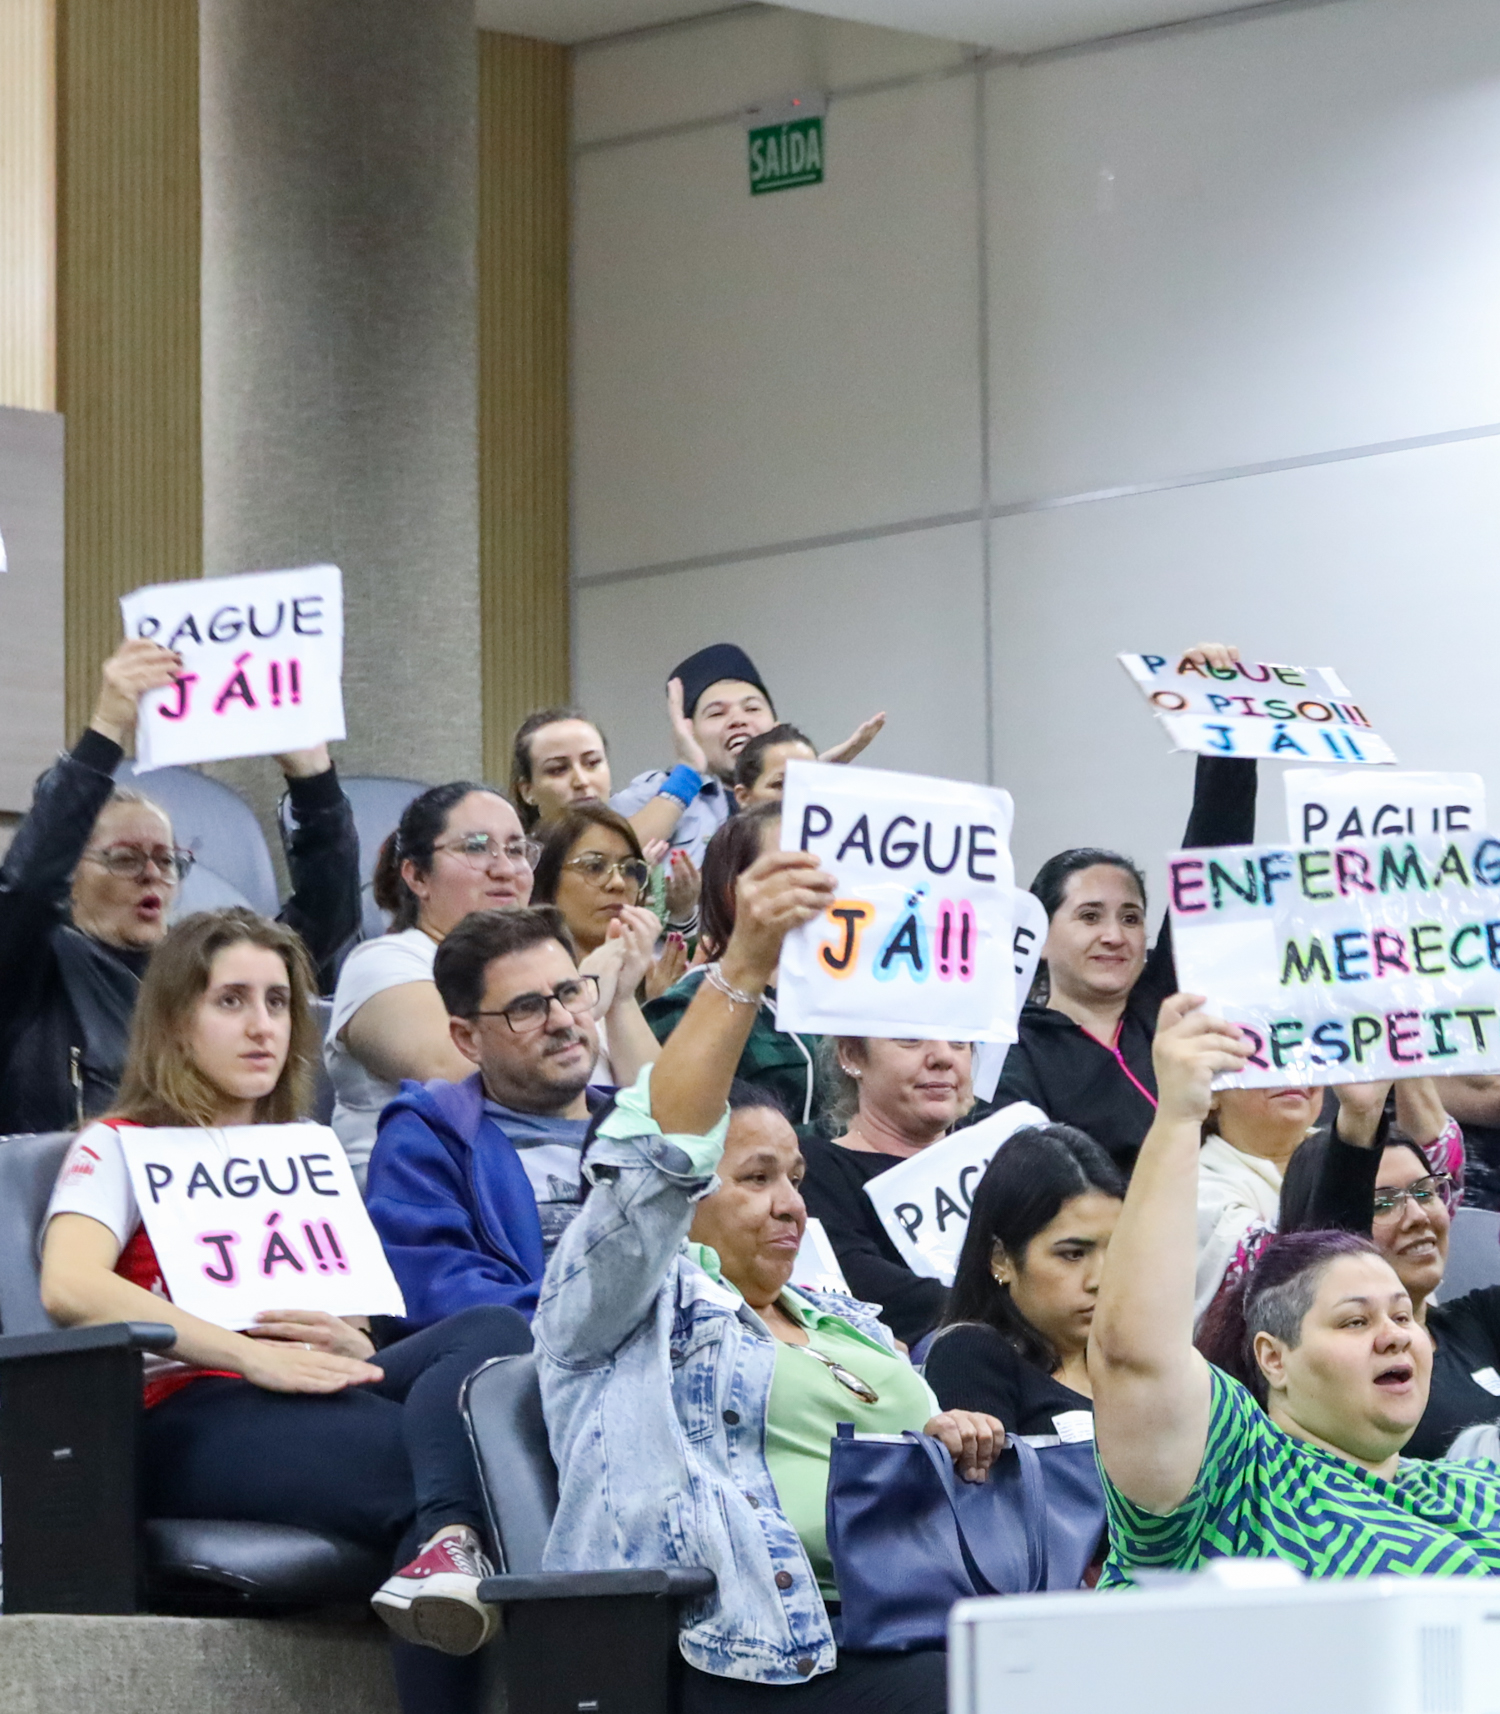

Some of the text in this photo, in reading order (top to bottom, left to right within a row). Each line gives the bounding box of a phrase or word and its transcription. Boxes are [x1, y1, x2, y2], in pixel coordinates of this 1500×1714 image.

[751, 125, 821, 180] SAÍDA
[157, 651, 302, 720] JÁ!!
[1149, 690, 1372, 728] O PISO!!!
[1202, 723, 1368, 761] JÁ!!
[800, 804, 997, 882] PAGUE
[818, 885, 976, 980] JÁ!!
[144, 1154, 340, 1204] PAGUE
[200, 1211, 348, 1283] JÁ!!
